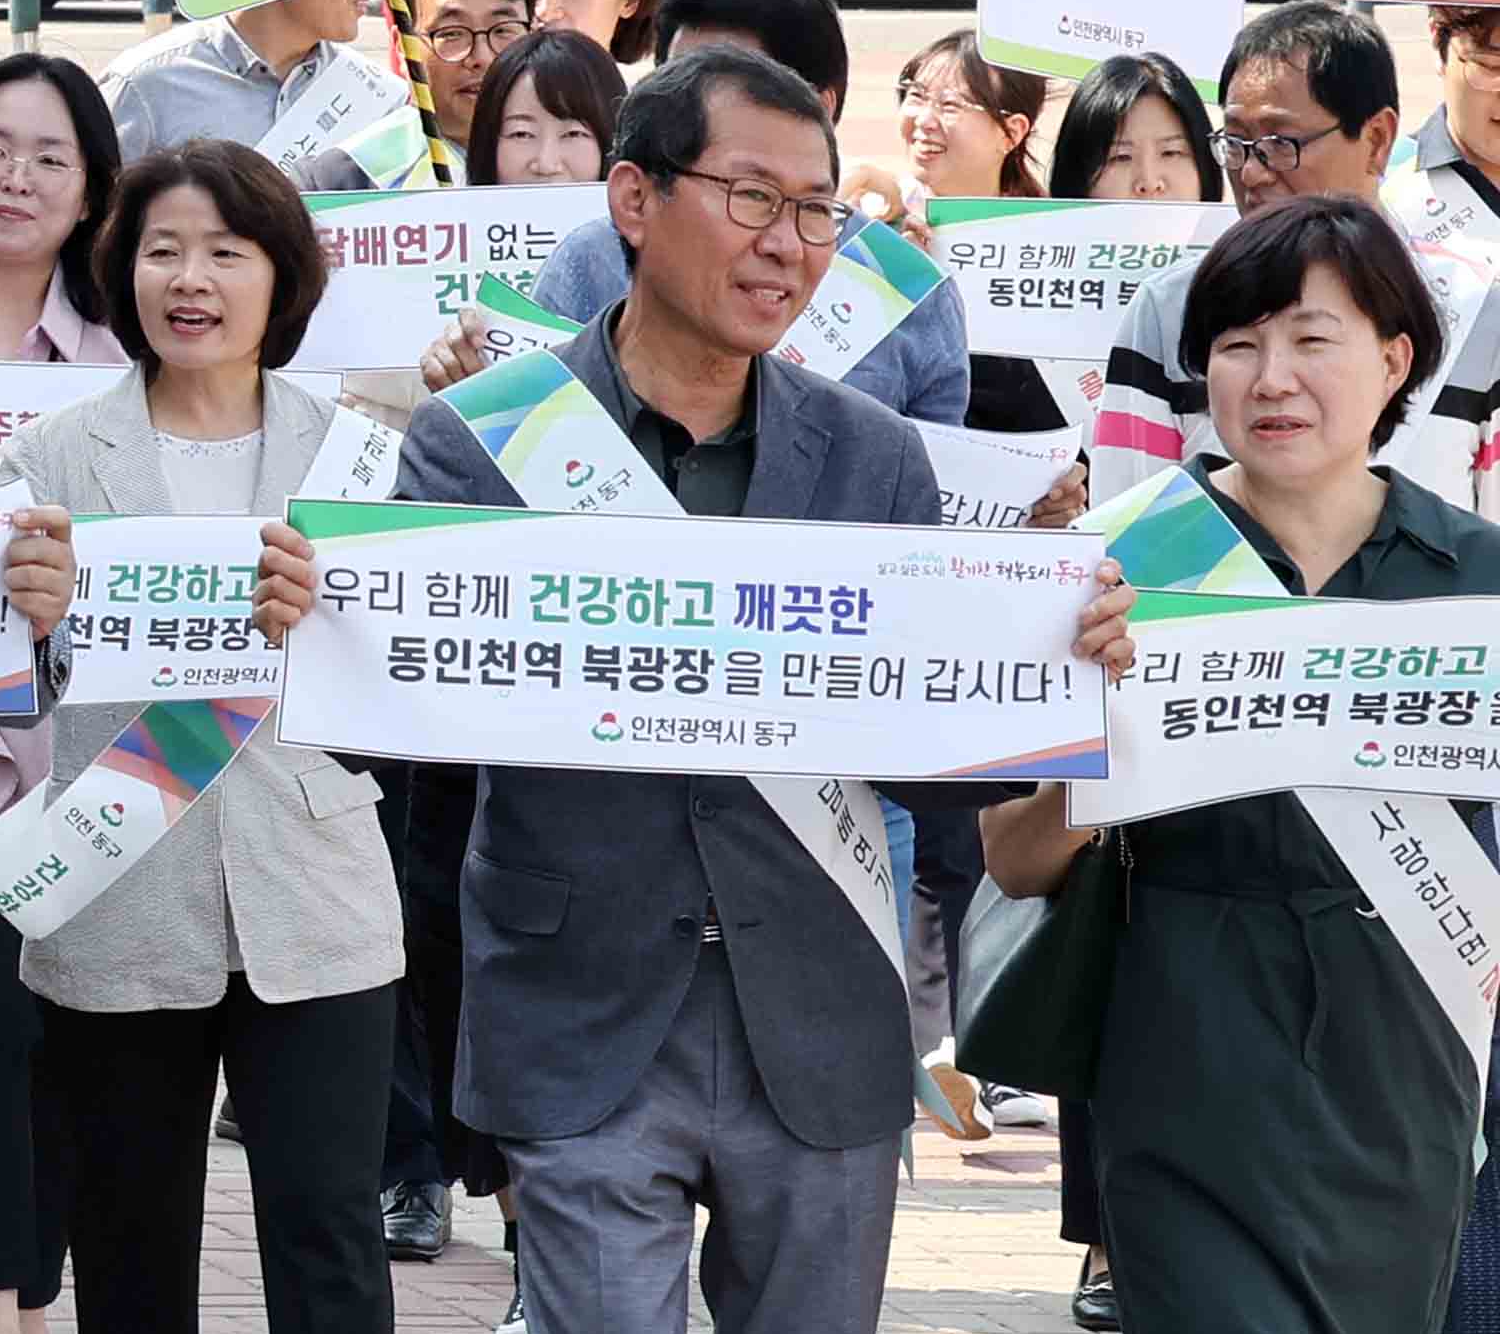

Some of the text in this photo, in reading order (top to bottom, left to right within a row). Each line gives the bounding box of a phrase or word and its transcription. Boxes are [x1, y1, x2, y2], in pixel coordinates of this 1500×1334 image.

[486, 222, 557, 262] 없는
[948, 242, 1007, 271] 우리
[1018, 243, 1076, 270] 함께
[987, 277, 1105, 311] 동인천역
[599, 469, 635, 504] 동구
[106, 563, 259, 605] 건강하고
[321, 569, 876, 638] 우리 함께 건강하고 깨끗한
[67, 616, 133, 652] 천역
[182, 666, 279, 686] 인천광역시
[386, 634, 564, 692] 동인천역
[780, 650, 905, 705] 만들어
[922, 656, 1076, 707] 갑시다!
[1200, 650, 1285, 682] 함께
[1301, 643, 1489, 683] 건강하고
[629, 715, 798, 747] 인천광역시 동구
[1161, 692, 1333, 743] 동인천역
[64, 806, 124, 859] 인천 동구
[1370, 800, 1491, 968] 사랑한다면
